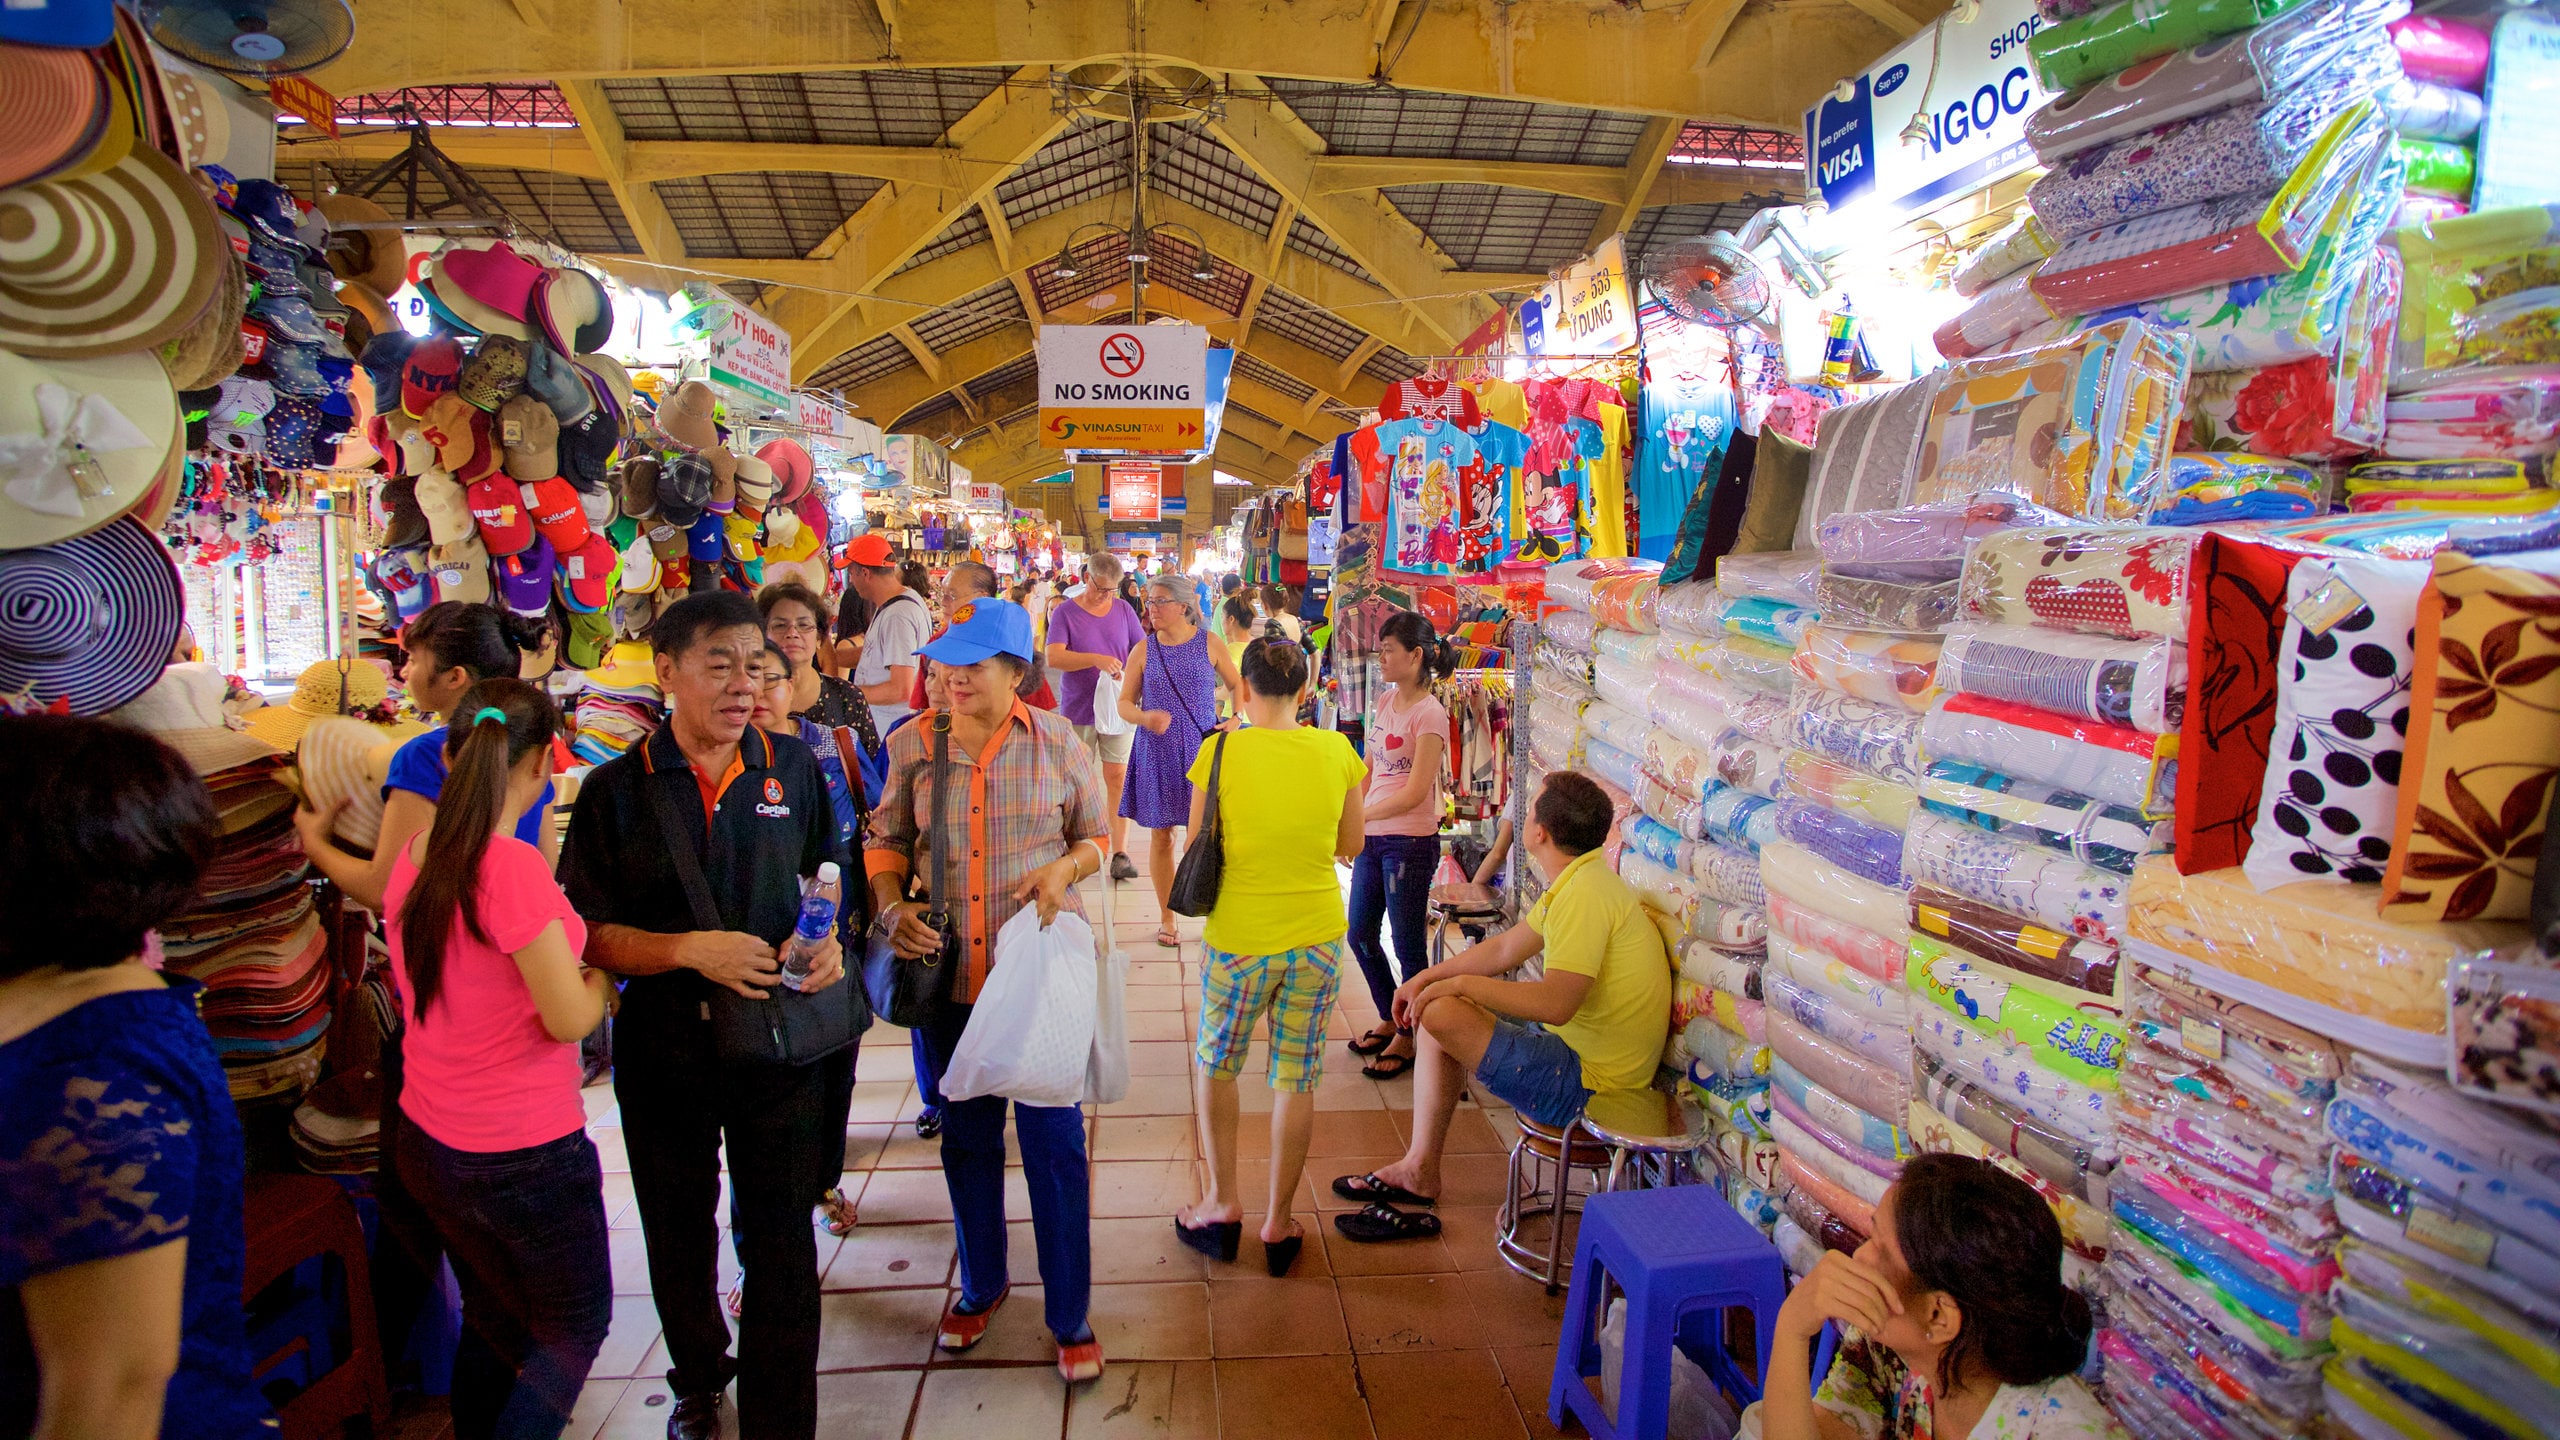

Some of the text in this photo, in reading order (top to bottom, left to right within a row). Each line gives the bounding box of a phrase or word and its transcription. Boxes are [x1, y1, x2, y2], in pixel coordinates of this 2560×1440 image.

[1990, 13, 2041, 60] SHOP
[1891, 69, 1904, 84] 515
[1820, 118, 1859, 148] we prefer
[1820, 143, 1864, 185] VISA
[1572, 290, 1586, 307] SHOP
[1590, 267, 1611, 299] 553
[733, 310, 775, 350] TỶ HOA
[1527, 330, 1543, 350] VISA
[1055, 383, 1190, 401] NO SMOKING
[422, 425, 449, 448] 5
[755, 803, 790, 817] Captain
